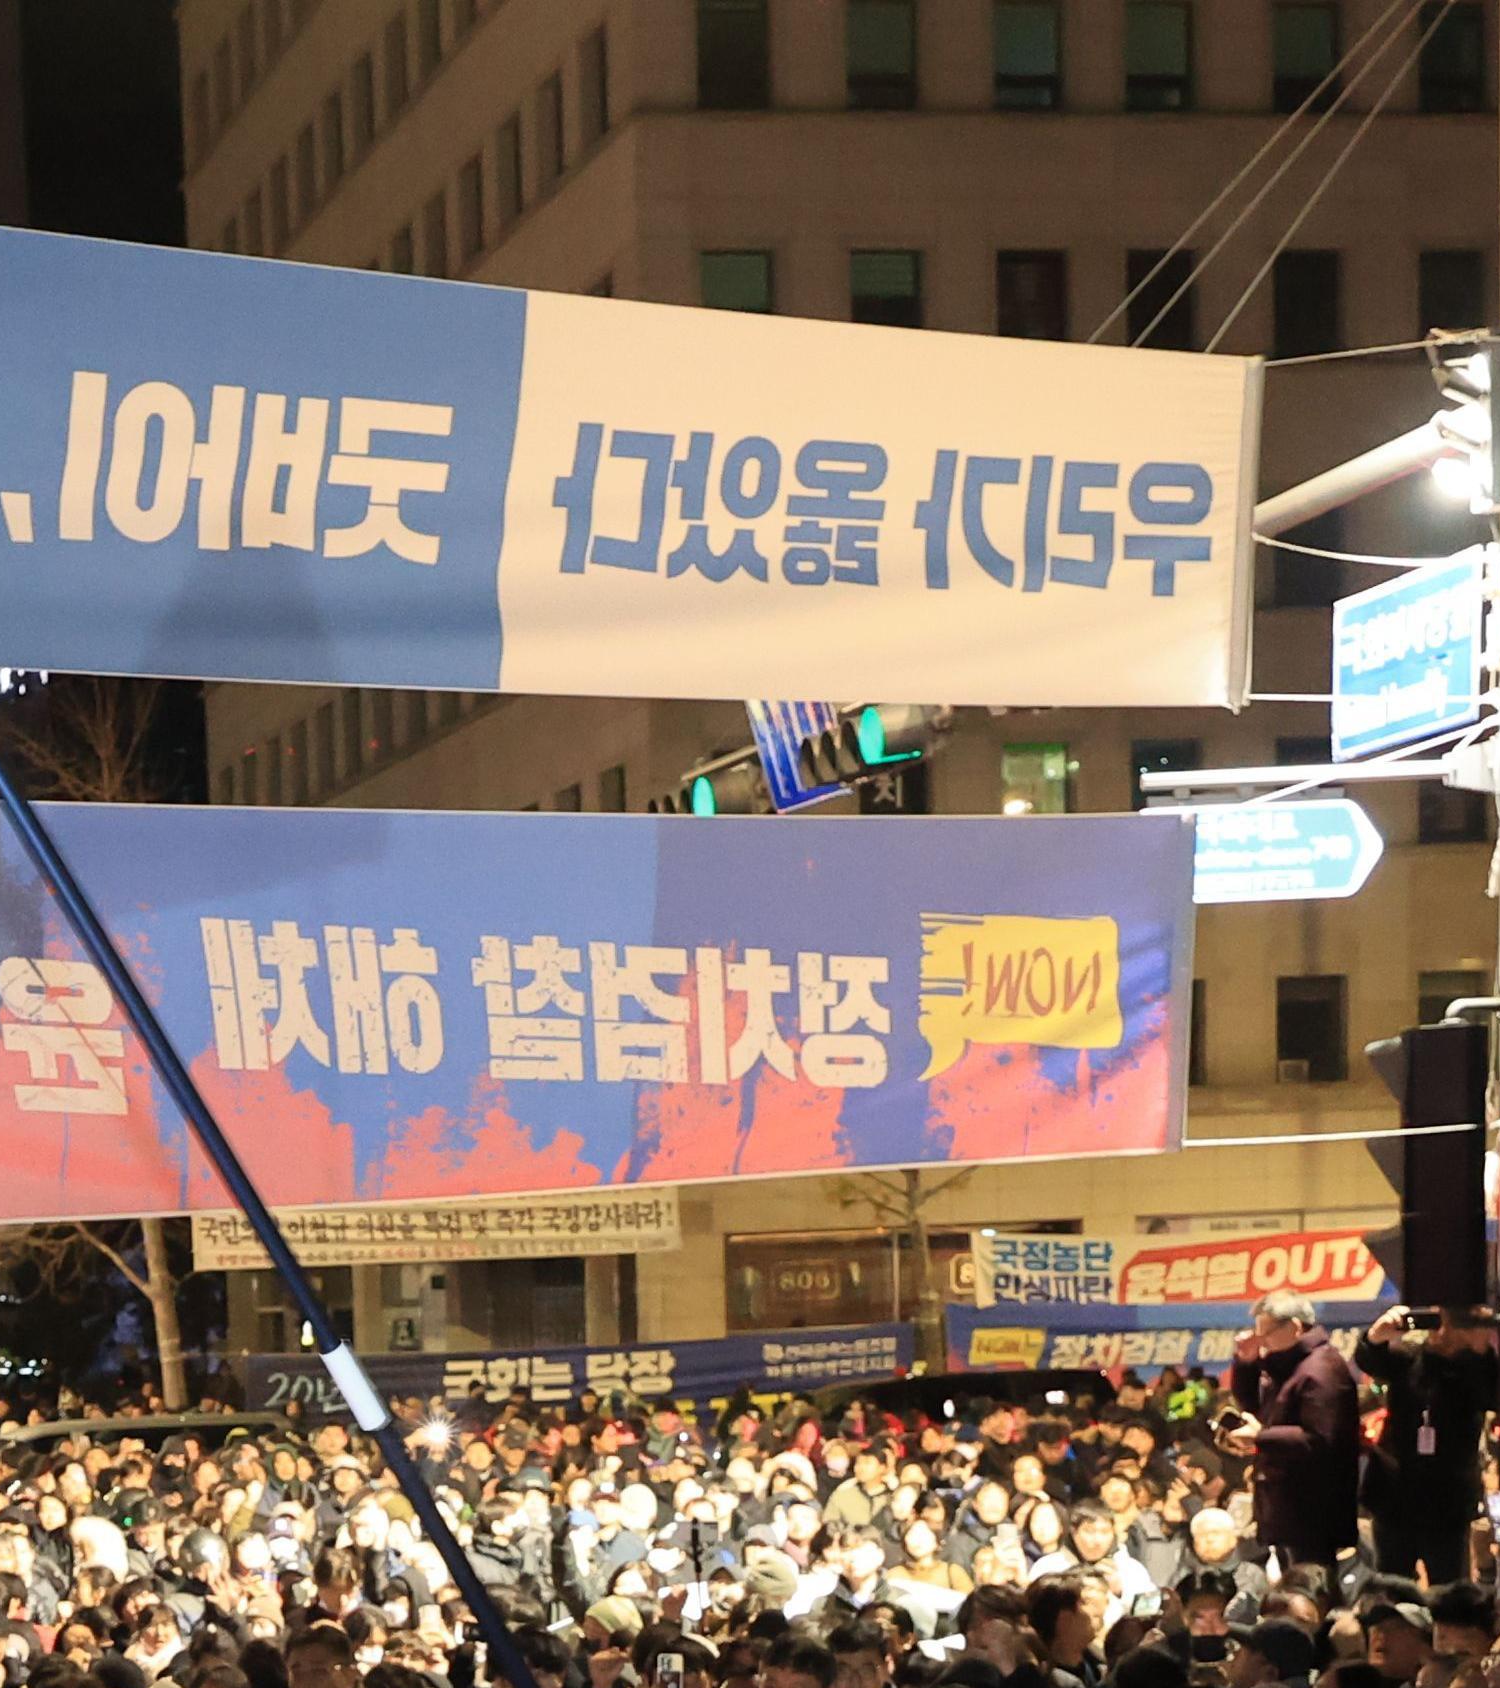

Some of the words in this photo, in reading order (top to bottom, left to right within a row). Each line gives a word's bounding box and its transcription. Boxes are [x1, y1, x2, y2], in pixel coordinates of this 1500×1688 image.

[991, 1240, 1112, 1271] 국정농단
[1125, 1251, 1250, 1304] 윤석열
[1049, 1330, 1194, 1369] 정치검찰
[444, 1356, 574, 1403] 국회는
